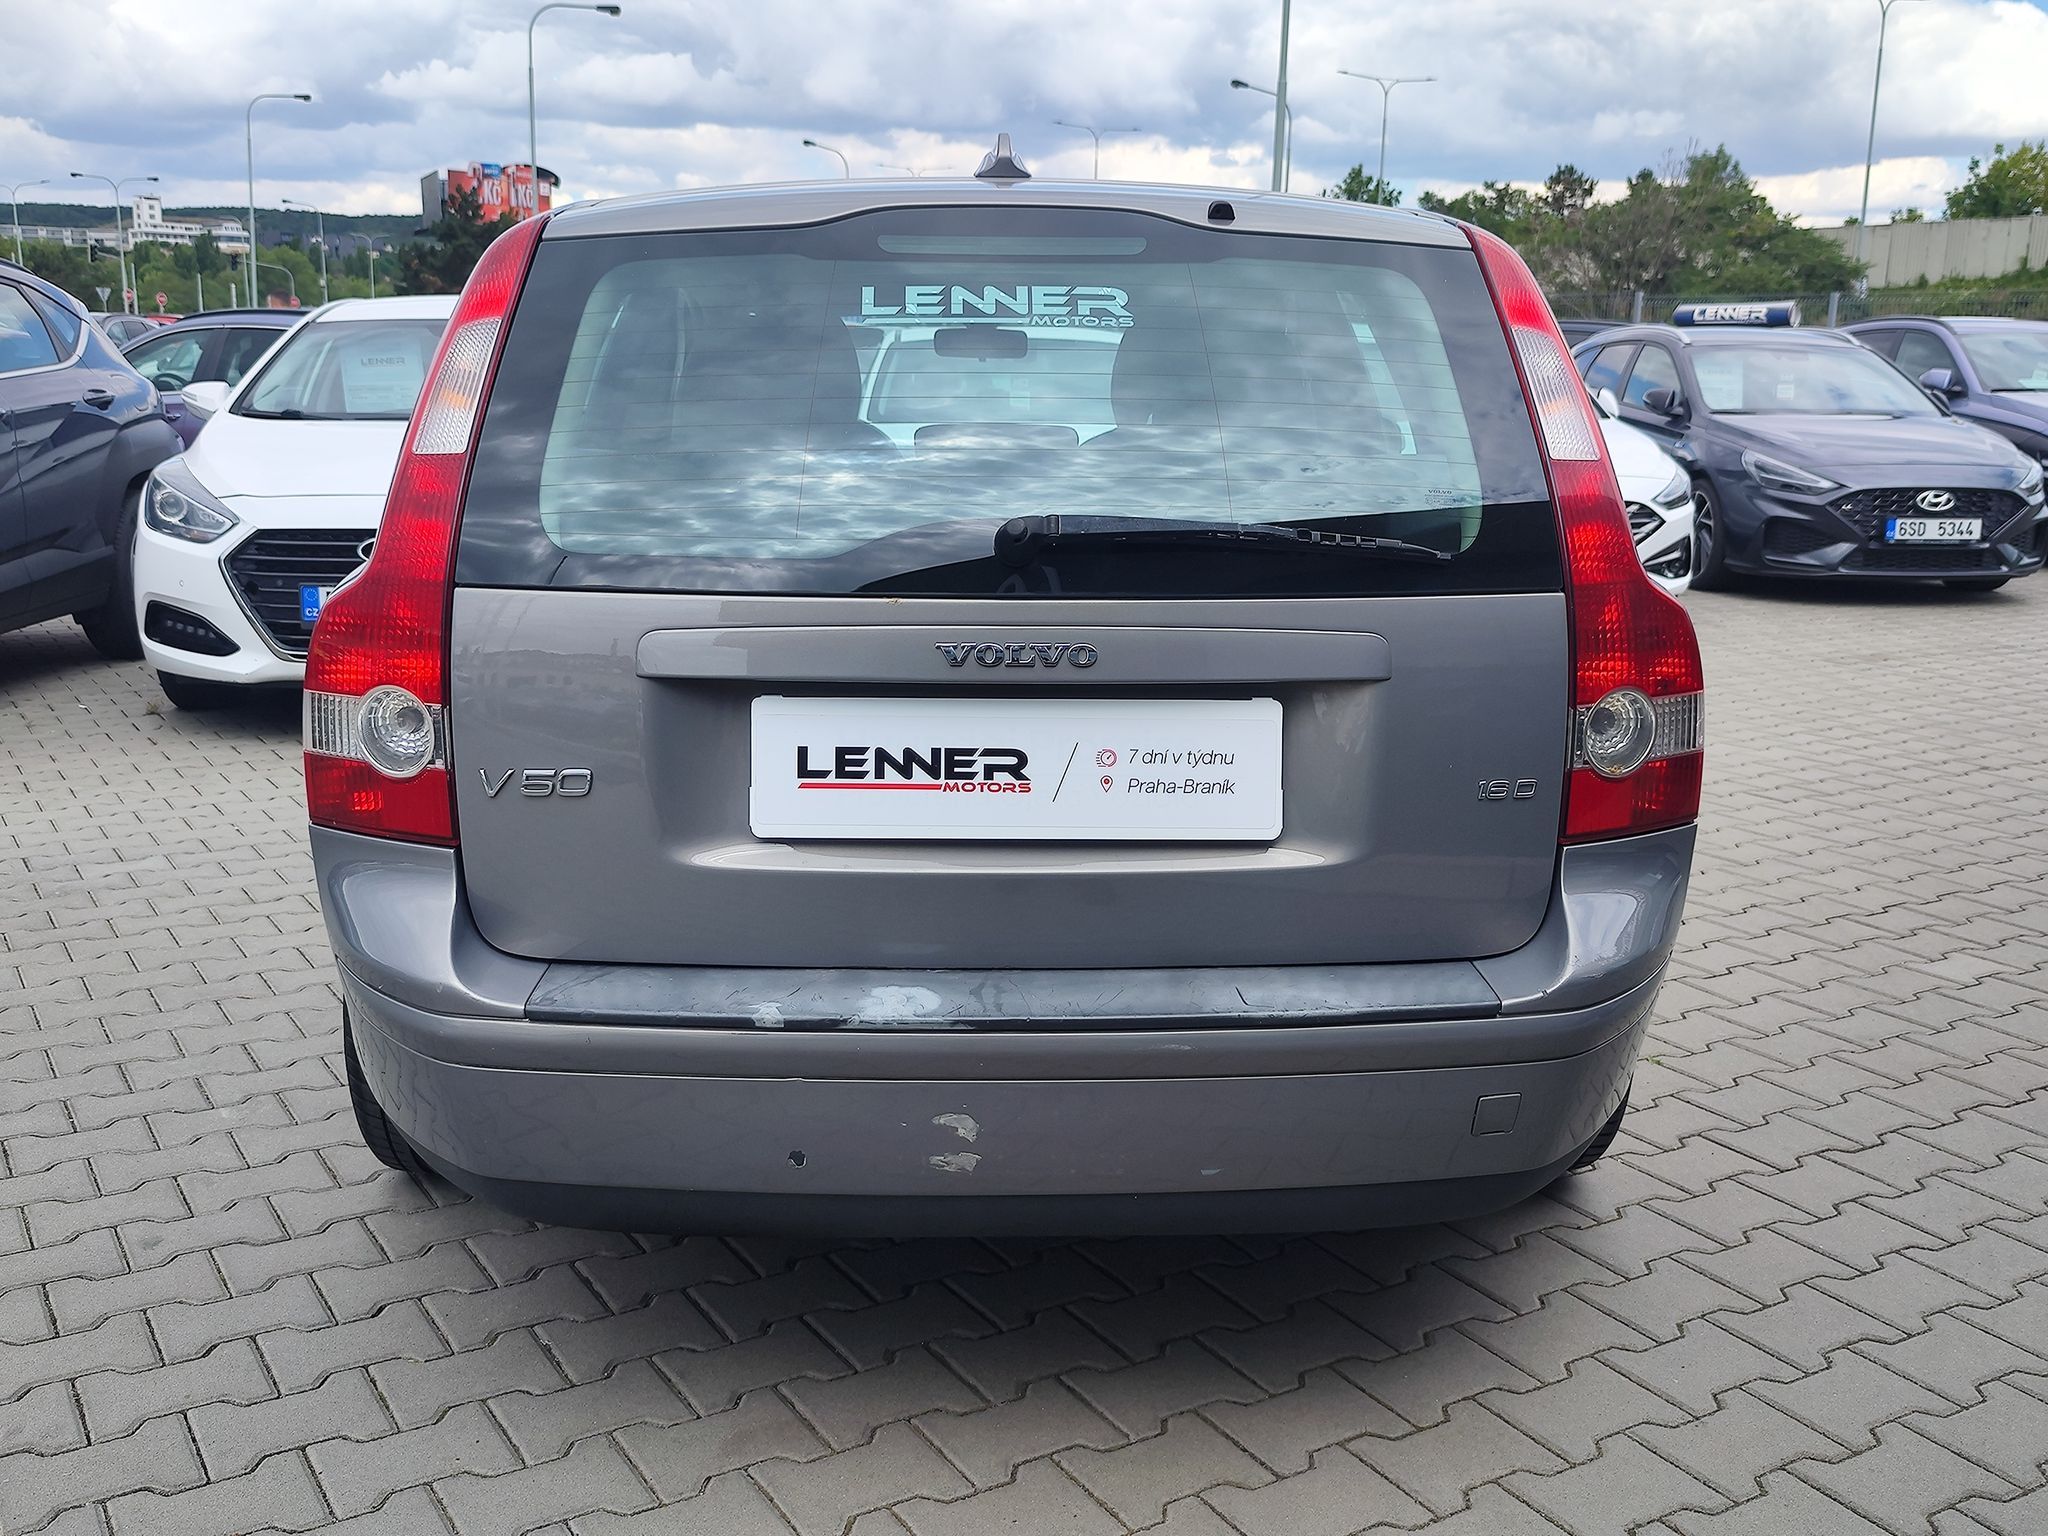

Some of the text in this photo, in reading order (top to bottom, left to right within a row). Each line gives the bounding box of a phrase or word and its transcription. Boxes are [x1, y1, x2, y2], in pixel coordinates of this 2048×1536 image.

[861, 285, 1134, 316] LENNER
[1030, 315, 1135, 328] MOTORS
[1693, 305, 1768, 321] LENNER
[1898, 521, 1927, 537] 6SD
[1937, 521, 1974, 537] 5344
[306, 607, 320, 617] CZ
[934, 641, 1099, 668] VOLVO
[797, 745, 1032, 781] LENNER
[1129, 748, 1235, 769] 7 dní v týdnu
[942, 781, 1032, 793] MOTORS
[1127, 777, 1236, 795] Praha-Braník
